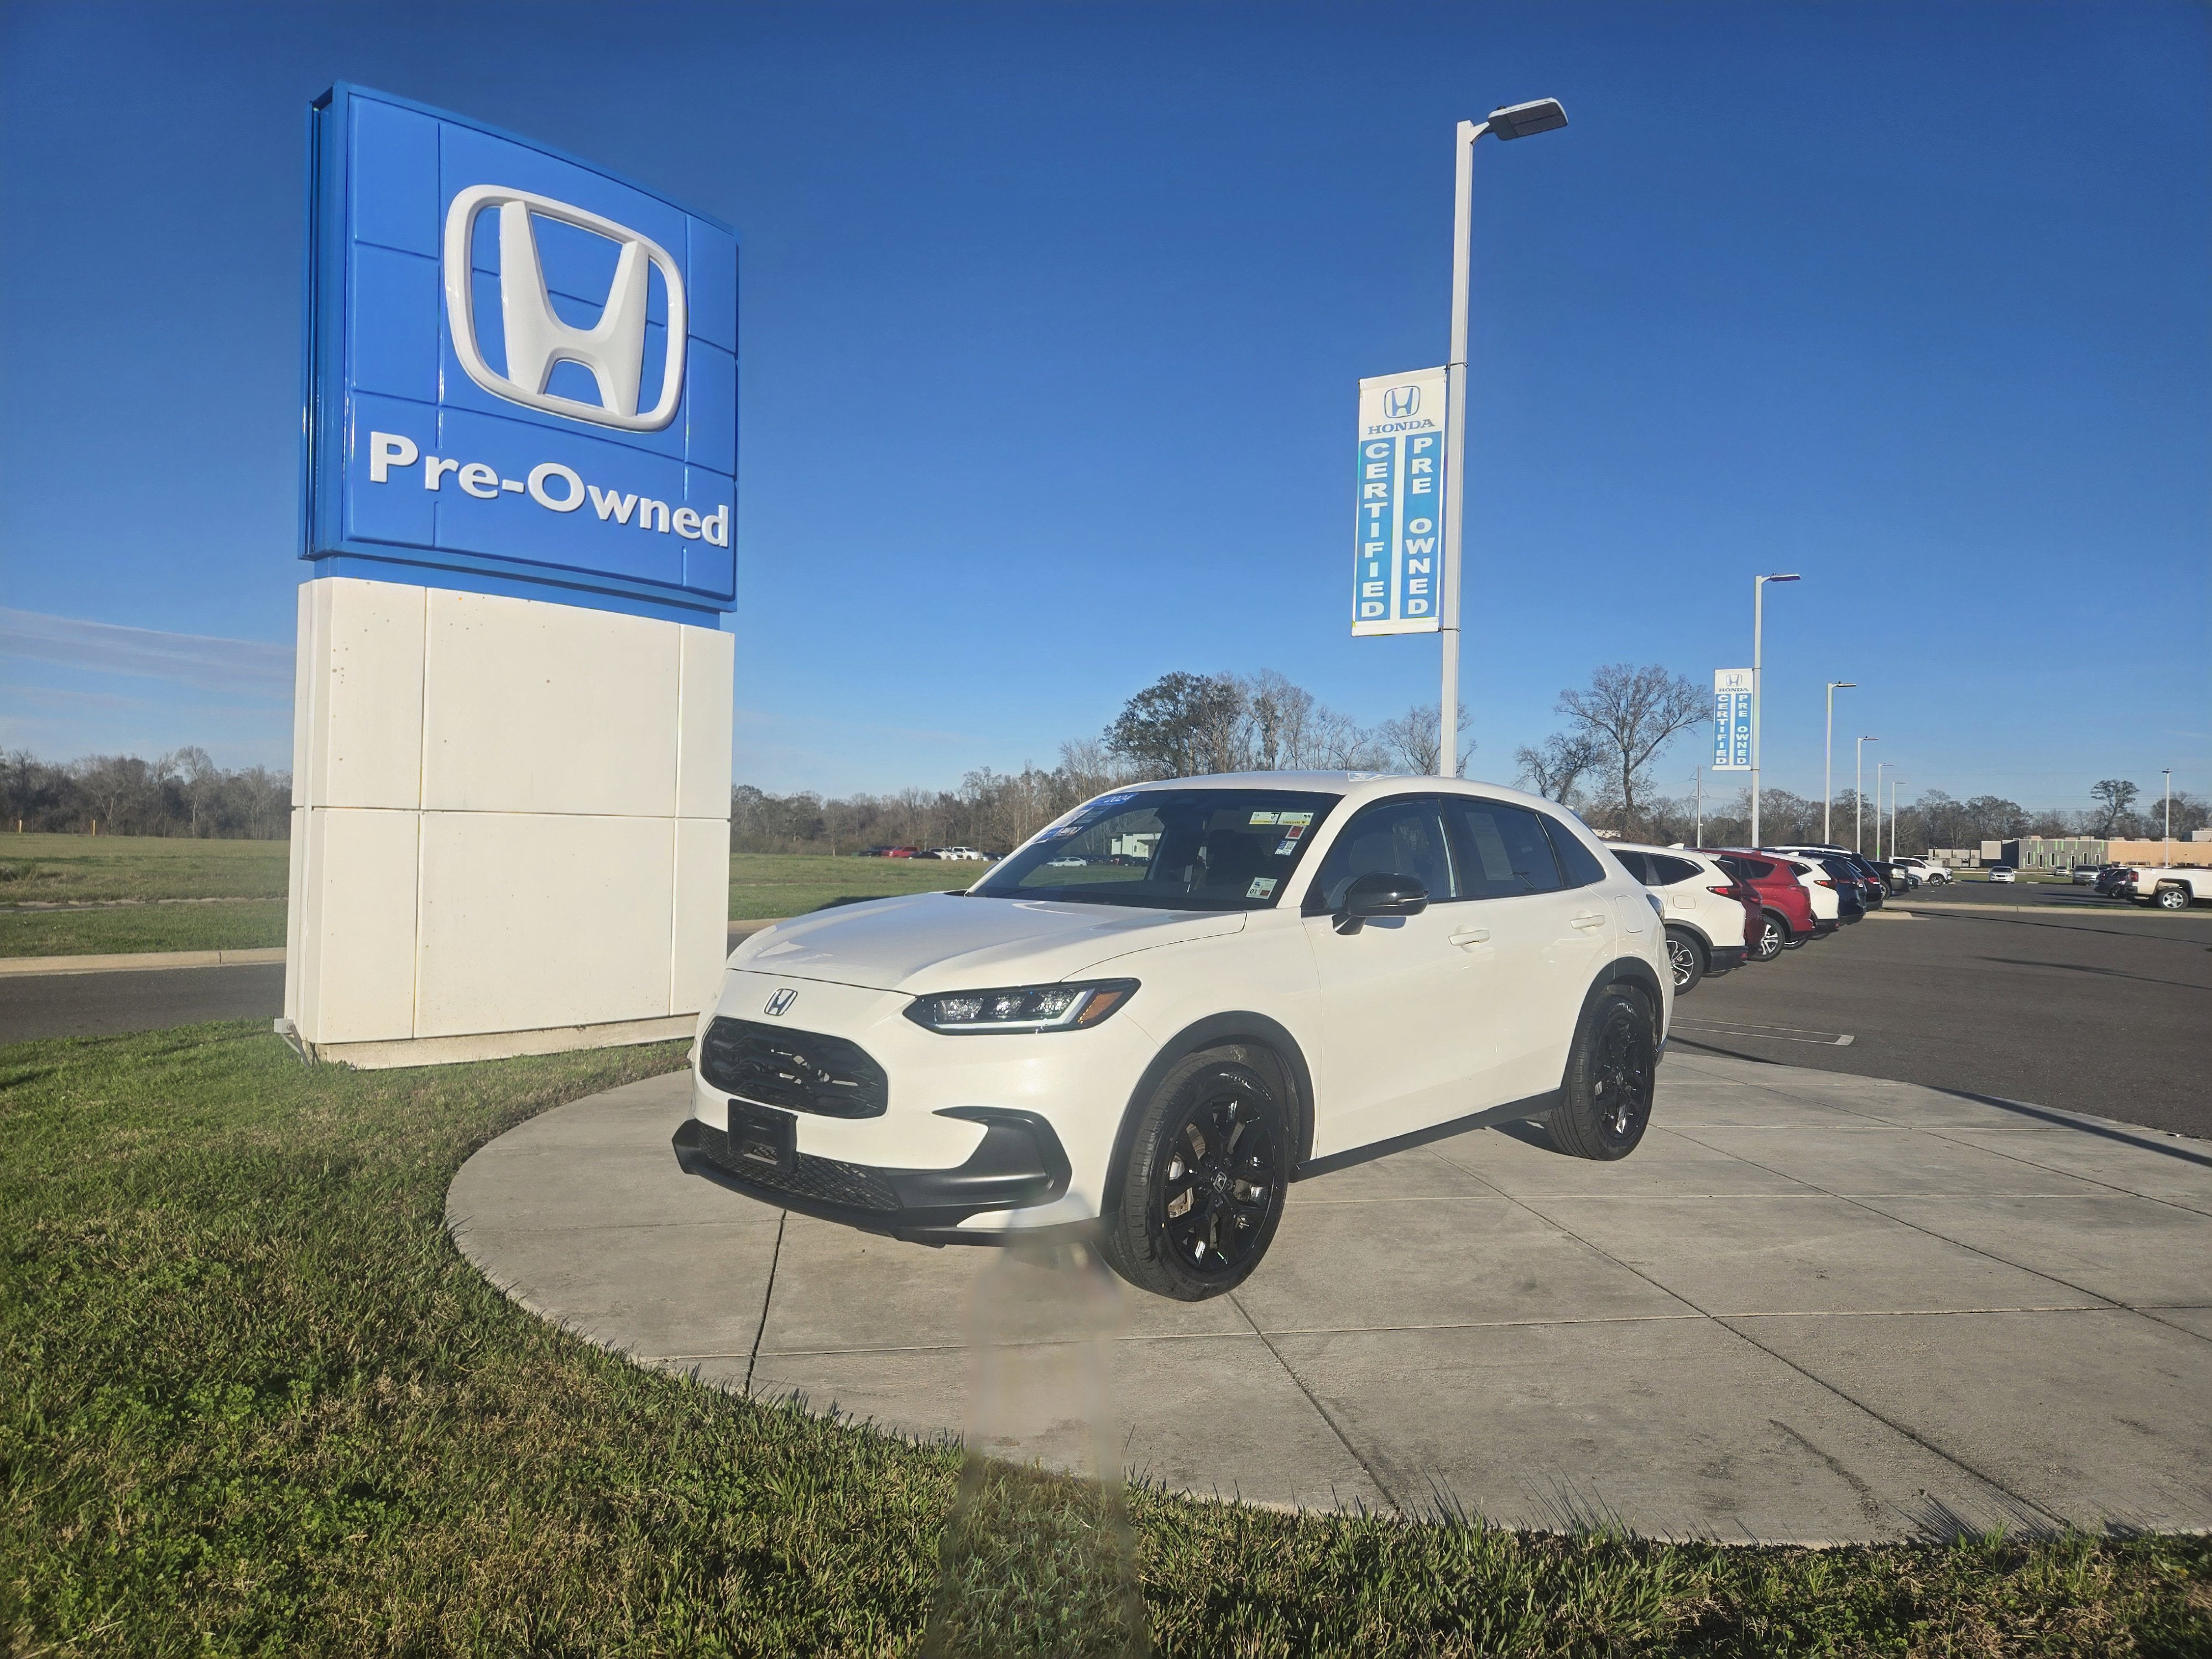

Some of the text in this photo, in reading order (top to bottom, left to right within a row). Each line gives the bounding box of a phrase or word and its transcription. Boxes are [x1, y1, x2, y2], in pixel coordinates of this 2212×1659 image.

[1368, 418, 1436, 435] HONDA
[369, 430, 730, 549] Pre-Owned
[1360, 442, 1390, 618] CERTIFIED
[1405, 436, 1436, 616] PRE OWNED
[1715, 695, 1729, 764] CERTIFIED
[1735, 695, 1750, 764] PRE OWNED
